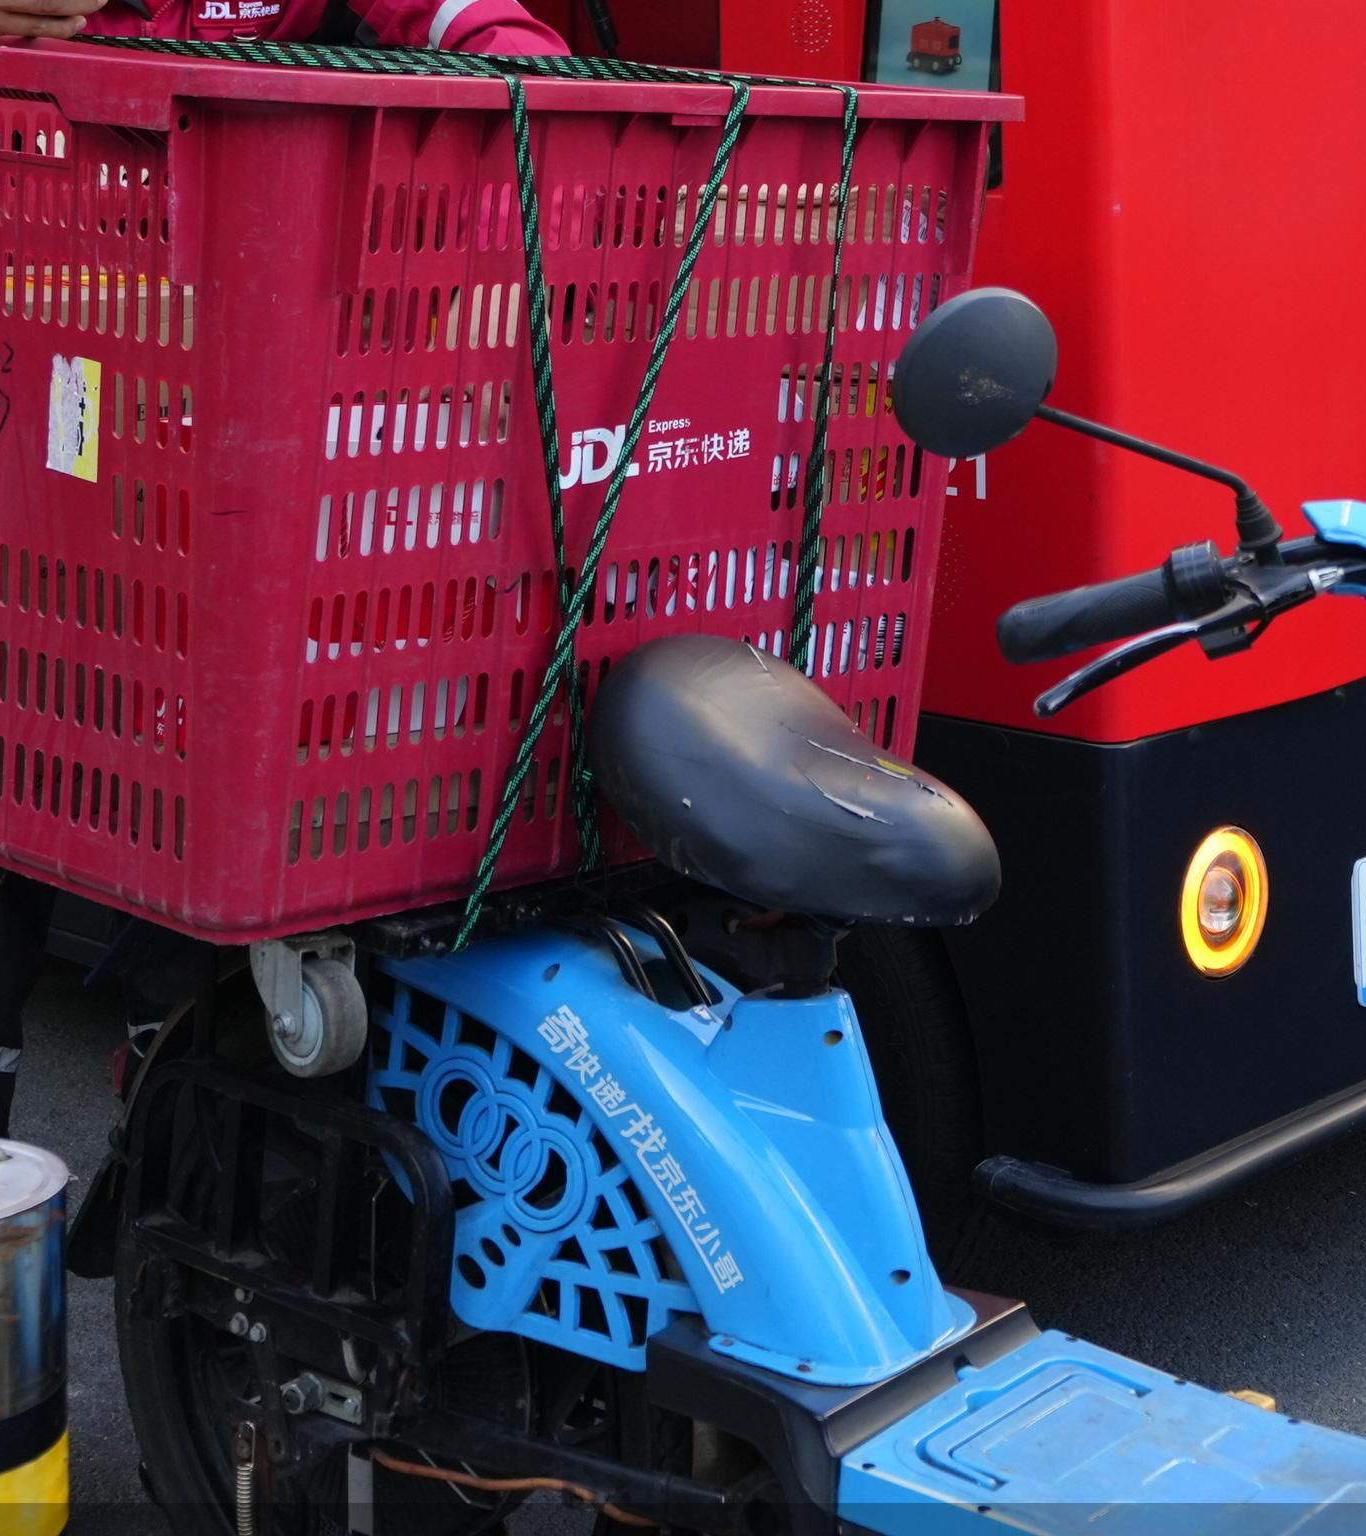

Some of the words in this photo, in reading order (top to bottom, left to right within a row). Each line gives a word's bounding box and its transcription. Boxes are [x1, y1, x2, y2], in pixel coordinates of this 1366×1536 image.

[199, 1, 236, 19] JDL
[648, 418, 691, 434] Express
[647, 428, 750, 473] 京东快递
